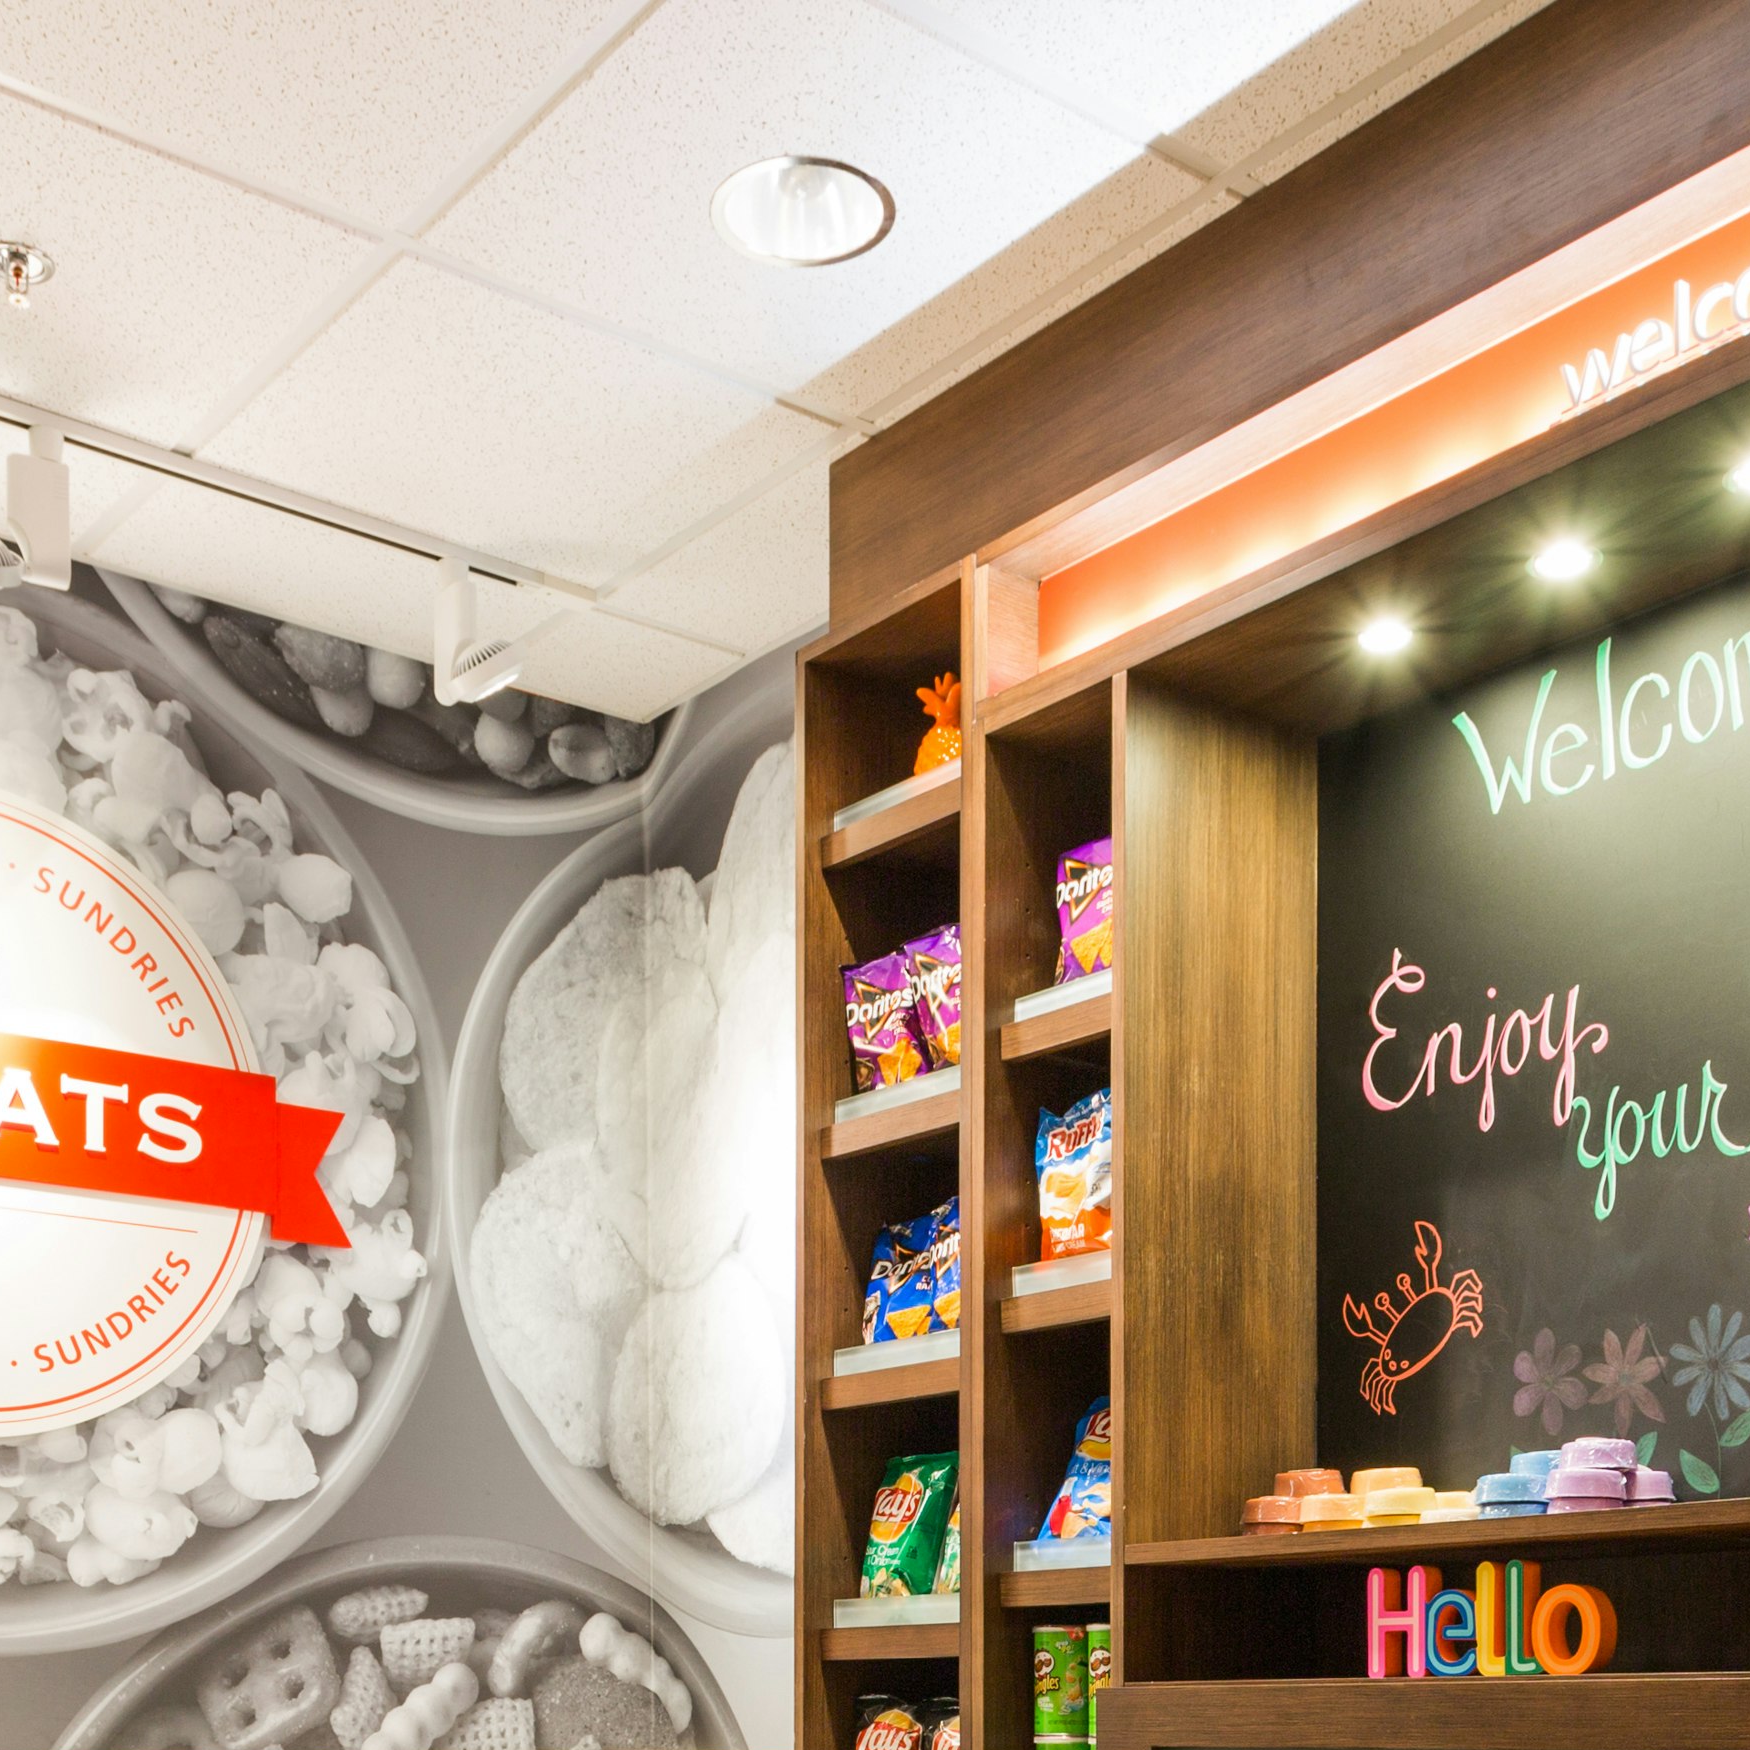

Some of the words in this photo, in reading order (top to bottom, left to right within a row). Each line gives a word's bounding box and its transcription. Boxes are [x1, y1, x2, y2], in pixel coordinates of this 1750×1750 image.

[33, 865, 197, 1041] SUNDRIES
[846, 987, 914, 1027] Doritos
[1362, 947, 1610, 1132] Enjoy
[33, 1249, 193, 1374] SUNDRIES
[1367, 1559, 1617, 1678] Hello
